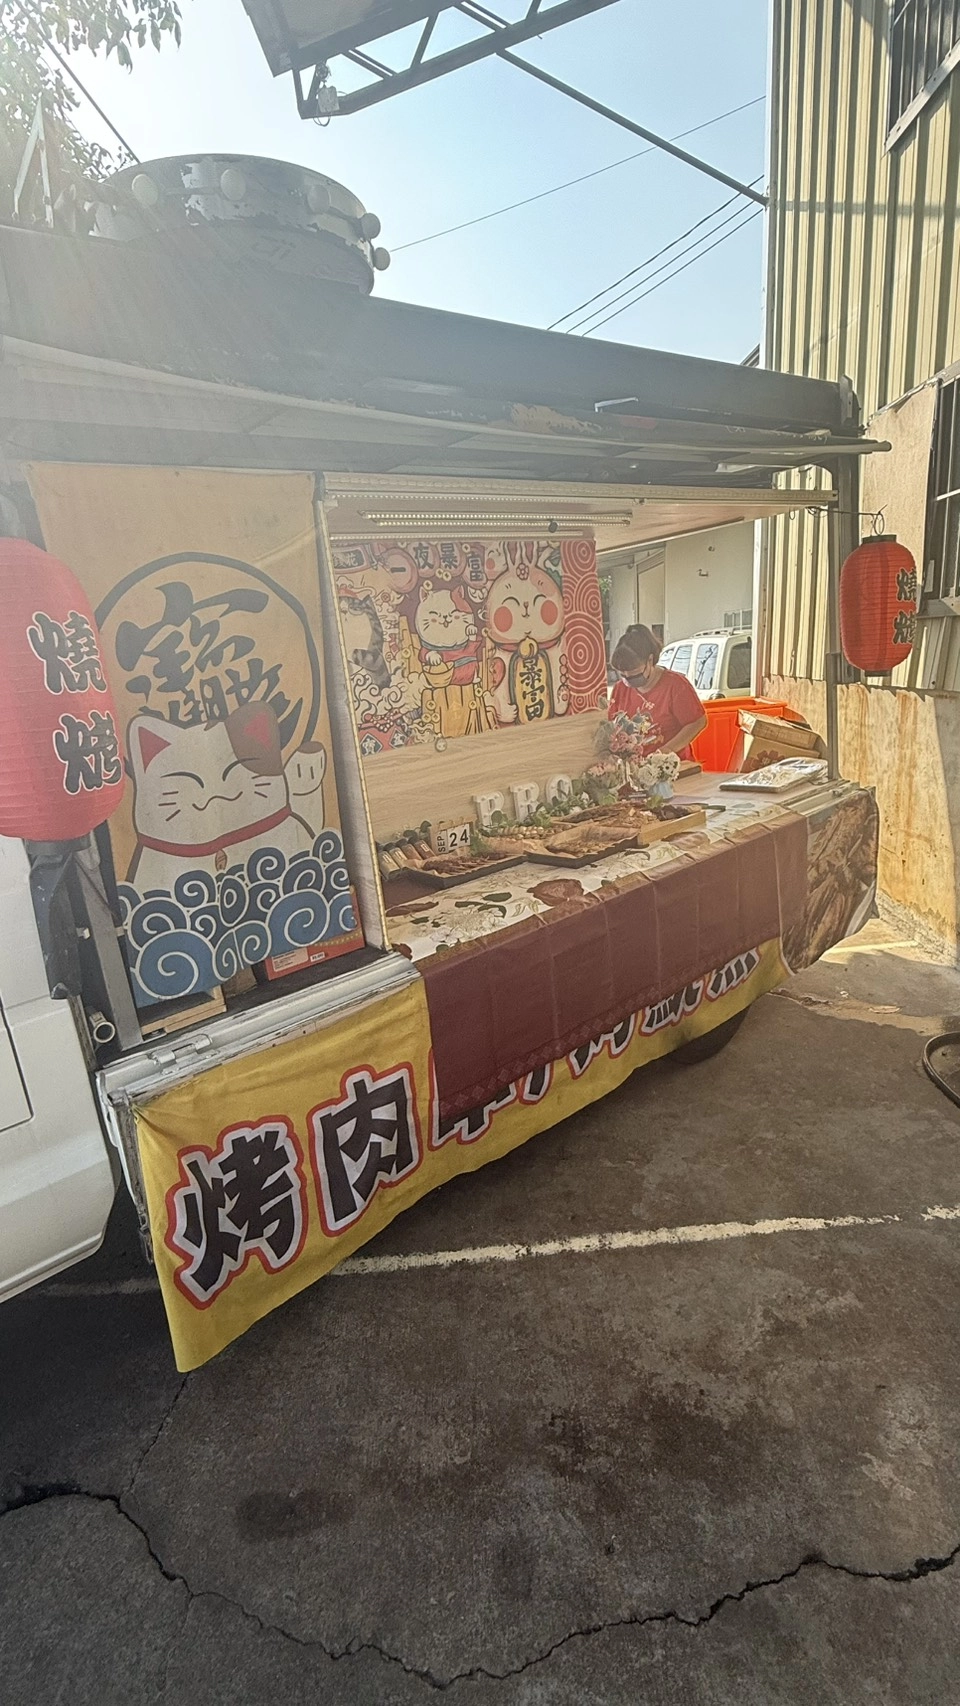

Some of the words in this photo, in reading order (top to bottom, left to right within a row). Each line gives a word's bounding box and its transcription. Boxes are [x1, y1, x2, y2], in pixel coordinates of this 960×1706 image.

[390, 542, 485, 582] 一夜暴富
[28, 611, 124, 796] 燒烤
[519, 657, 545, 722] 暴富
[437, 835, 446, 853] SEP
[449, 829, 470, 848] 24
